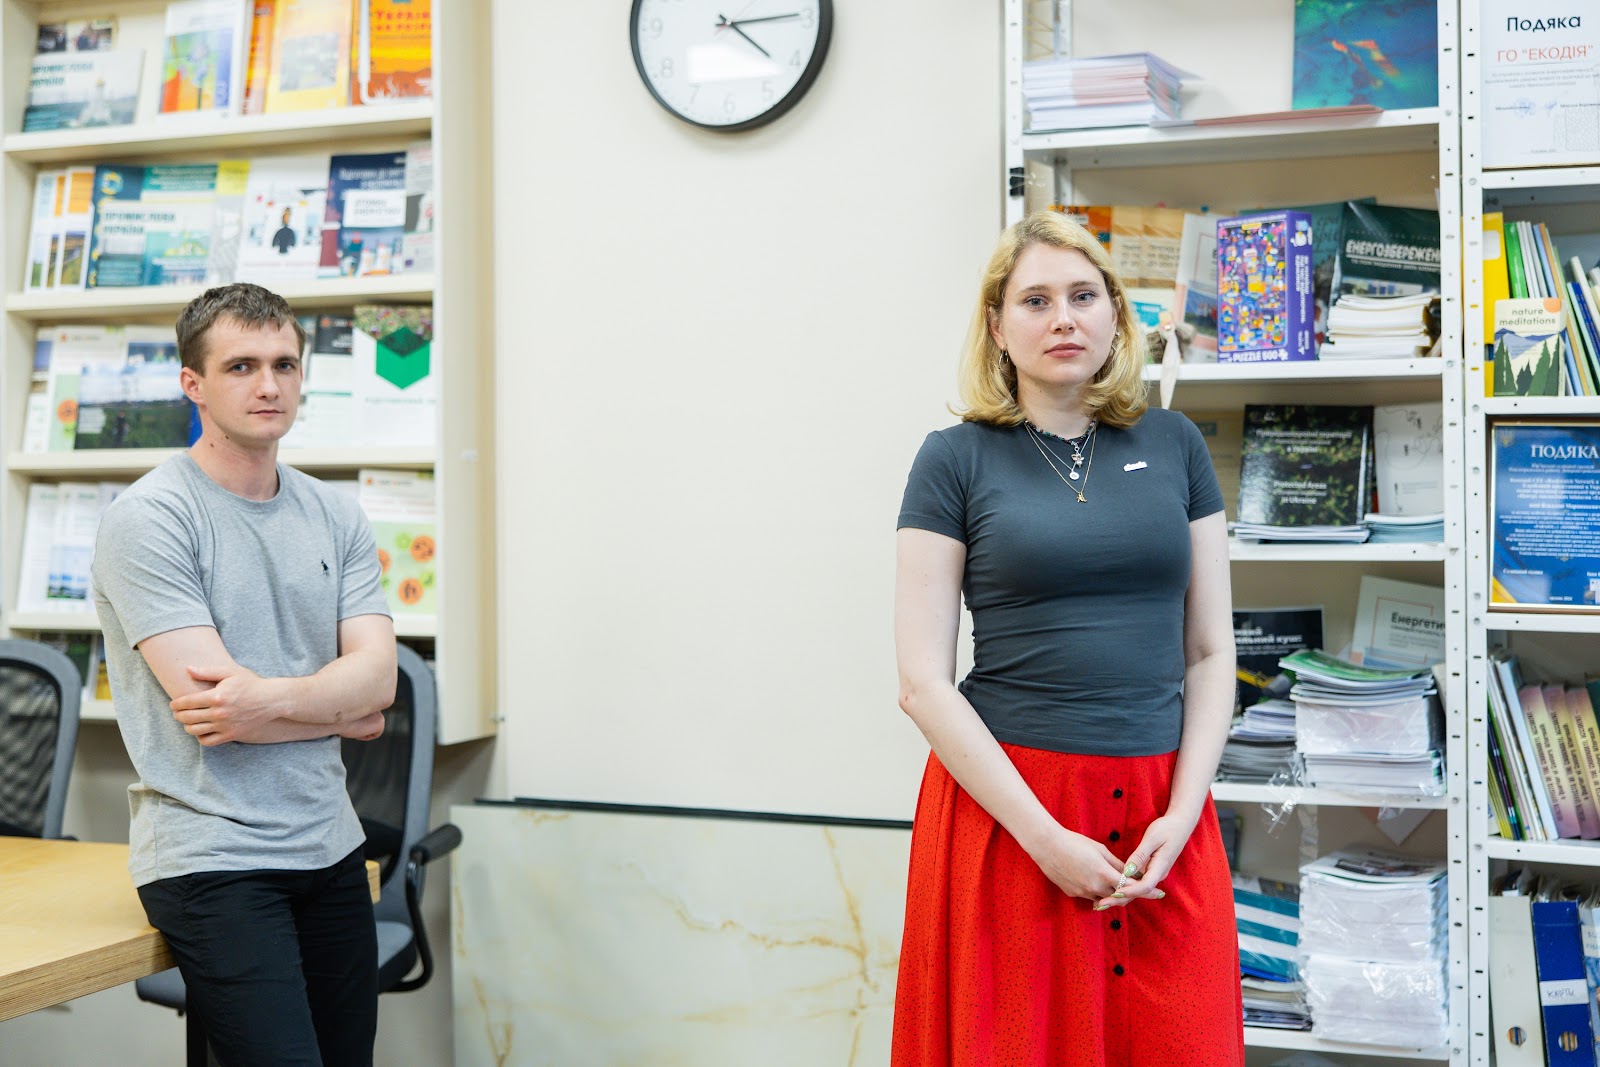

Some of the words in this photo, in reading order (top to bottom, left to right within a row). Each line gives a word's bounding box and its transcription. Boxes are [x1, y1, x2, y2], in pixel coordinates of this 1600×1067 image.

[802, 8, 814, 29] 3
[1507, 16, 1581, 32] Подяка
[650, 17, 663, 39] 9
[789, 50, 801, 66] 4
[1498, 50, 1518, 62] ГО
[660, 58, 674, 78] 8
[688, 84, 700, 104] 7
[762, 80, 774, 100] 5
[723, 92, 736, 114] 6
[1499, 316, 1556, 326] meditations
[1512, 308, 1543, 316] nature
[1530, 444, 1599, 460] ПОДЯКА
